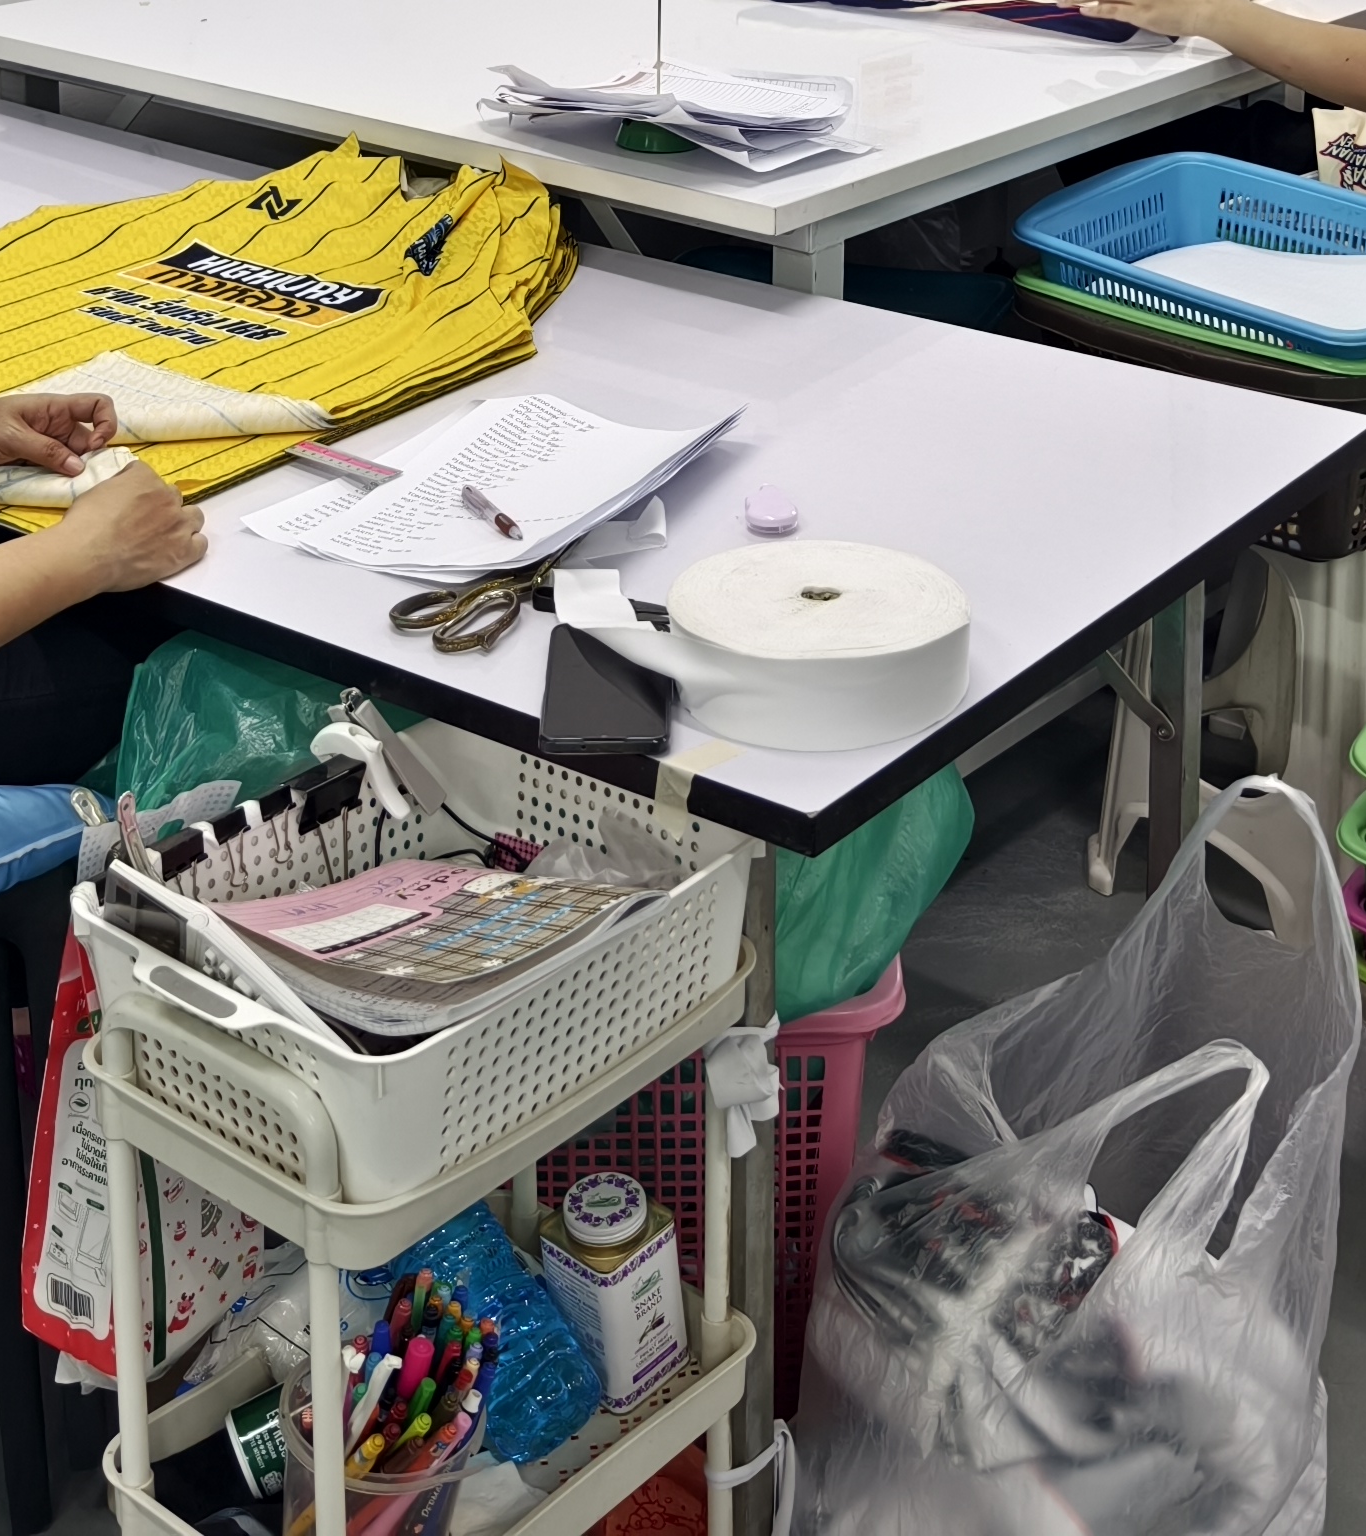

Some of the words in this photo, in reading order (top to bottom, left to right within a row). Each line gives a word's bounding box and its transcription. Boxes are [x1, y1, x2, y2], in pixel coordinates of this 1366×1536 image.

[187, 253, 362, 306] HIGHWAY
[71, 1120, 107, 1148] เนื้อกระดา
[633, 1285, 662, 1312] SNAKE
[635, 1294, 663, 1321] BRAND
